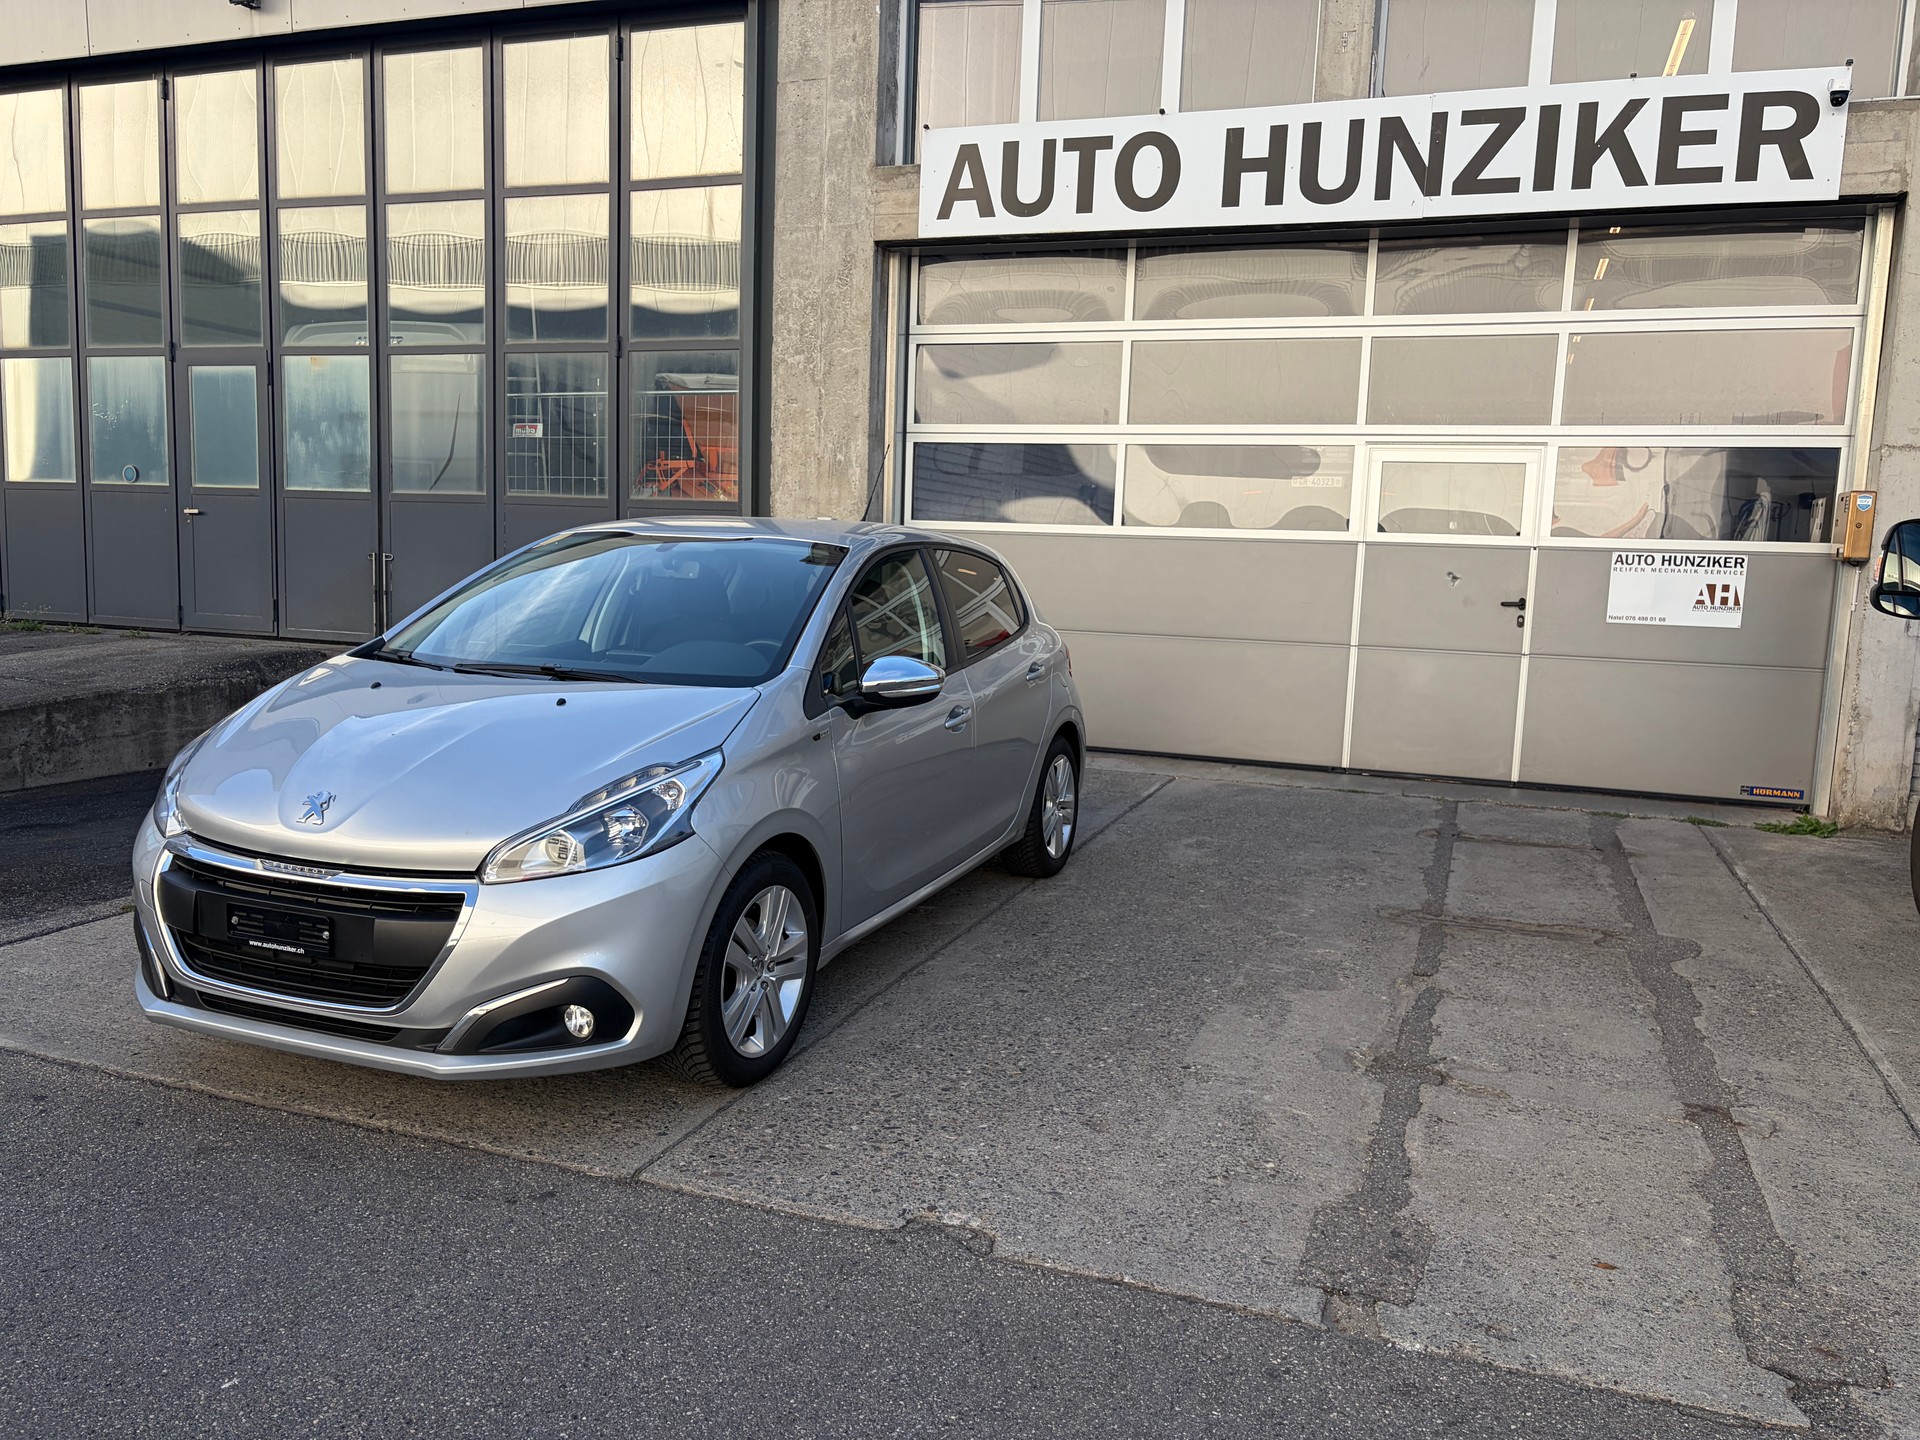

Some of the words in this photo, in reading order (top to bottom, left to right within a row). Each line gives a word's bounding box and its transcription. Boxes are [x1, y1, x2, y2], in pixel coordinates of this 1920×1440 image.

[937, 131, 1181, 221] AUTO
[1220, 89, 1822, 208] HUNZIKER
[1614, 554, 1656, 566] AUTO
[1661, 555, 1745, 569] HUNZIKER
[1651, 567, 1699, 575] MECHANIK
[249, 939, 305, 954] www.autohunziker.ch
